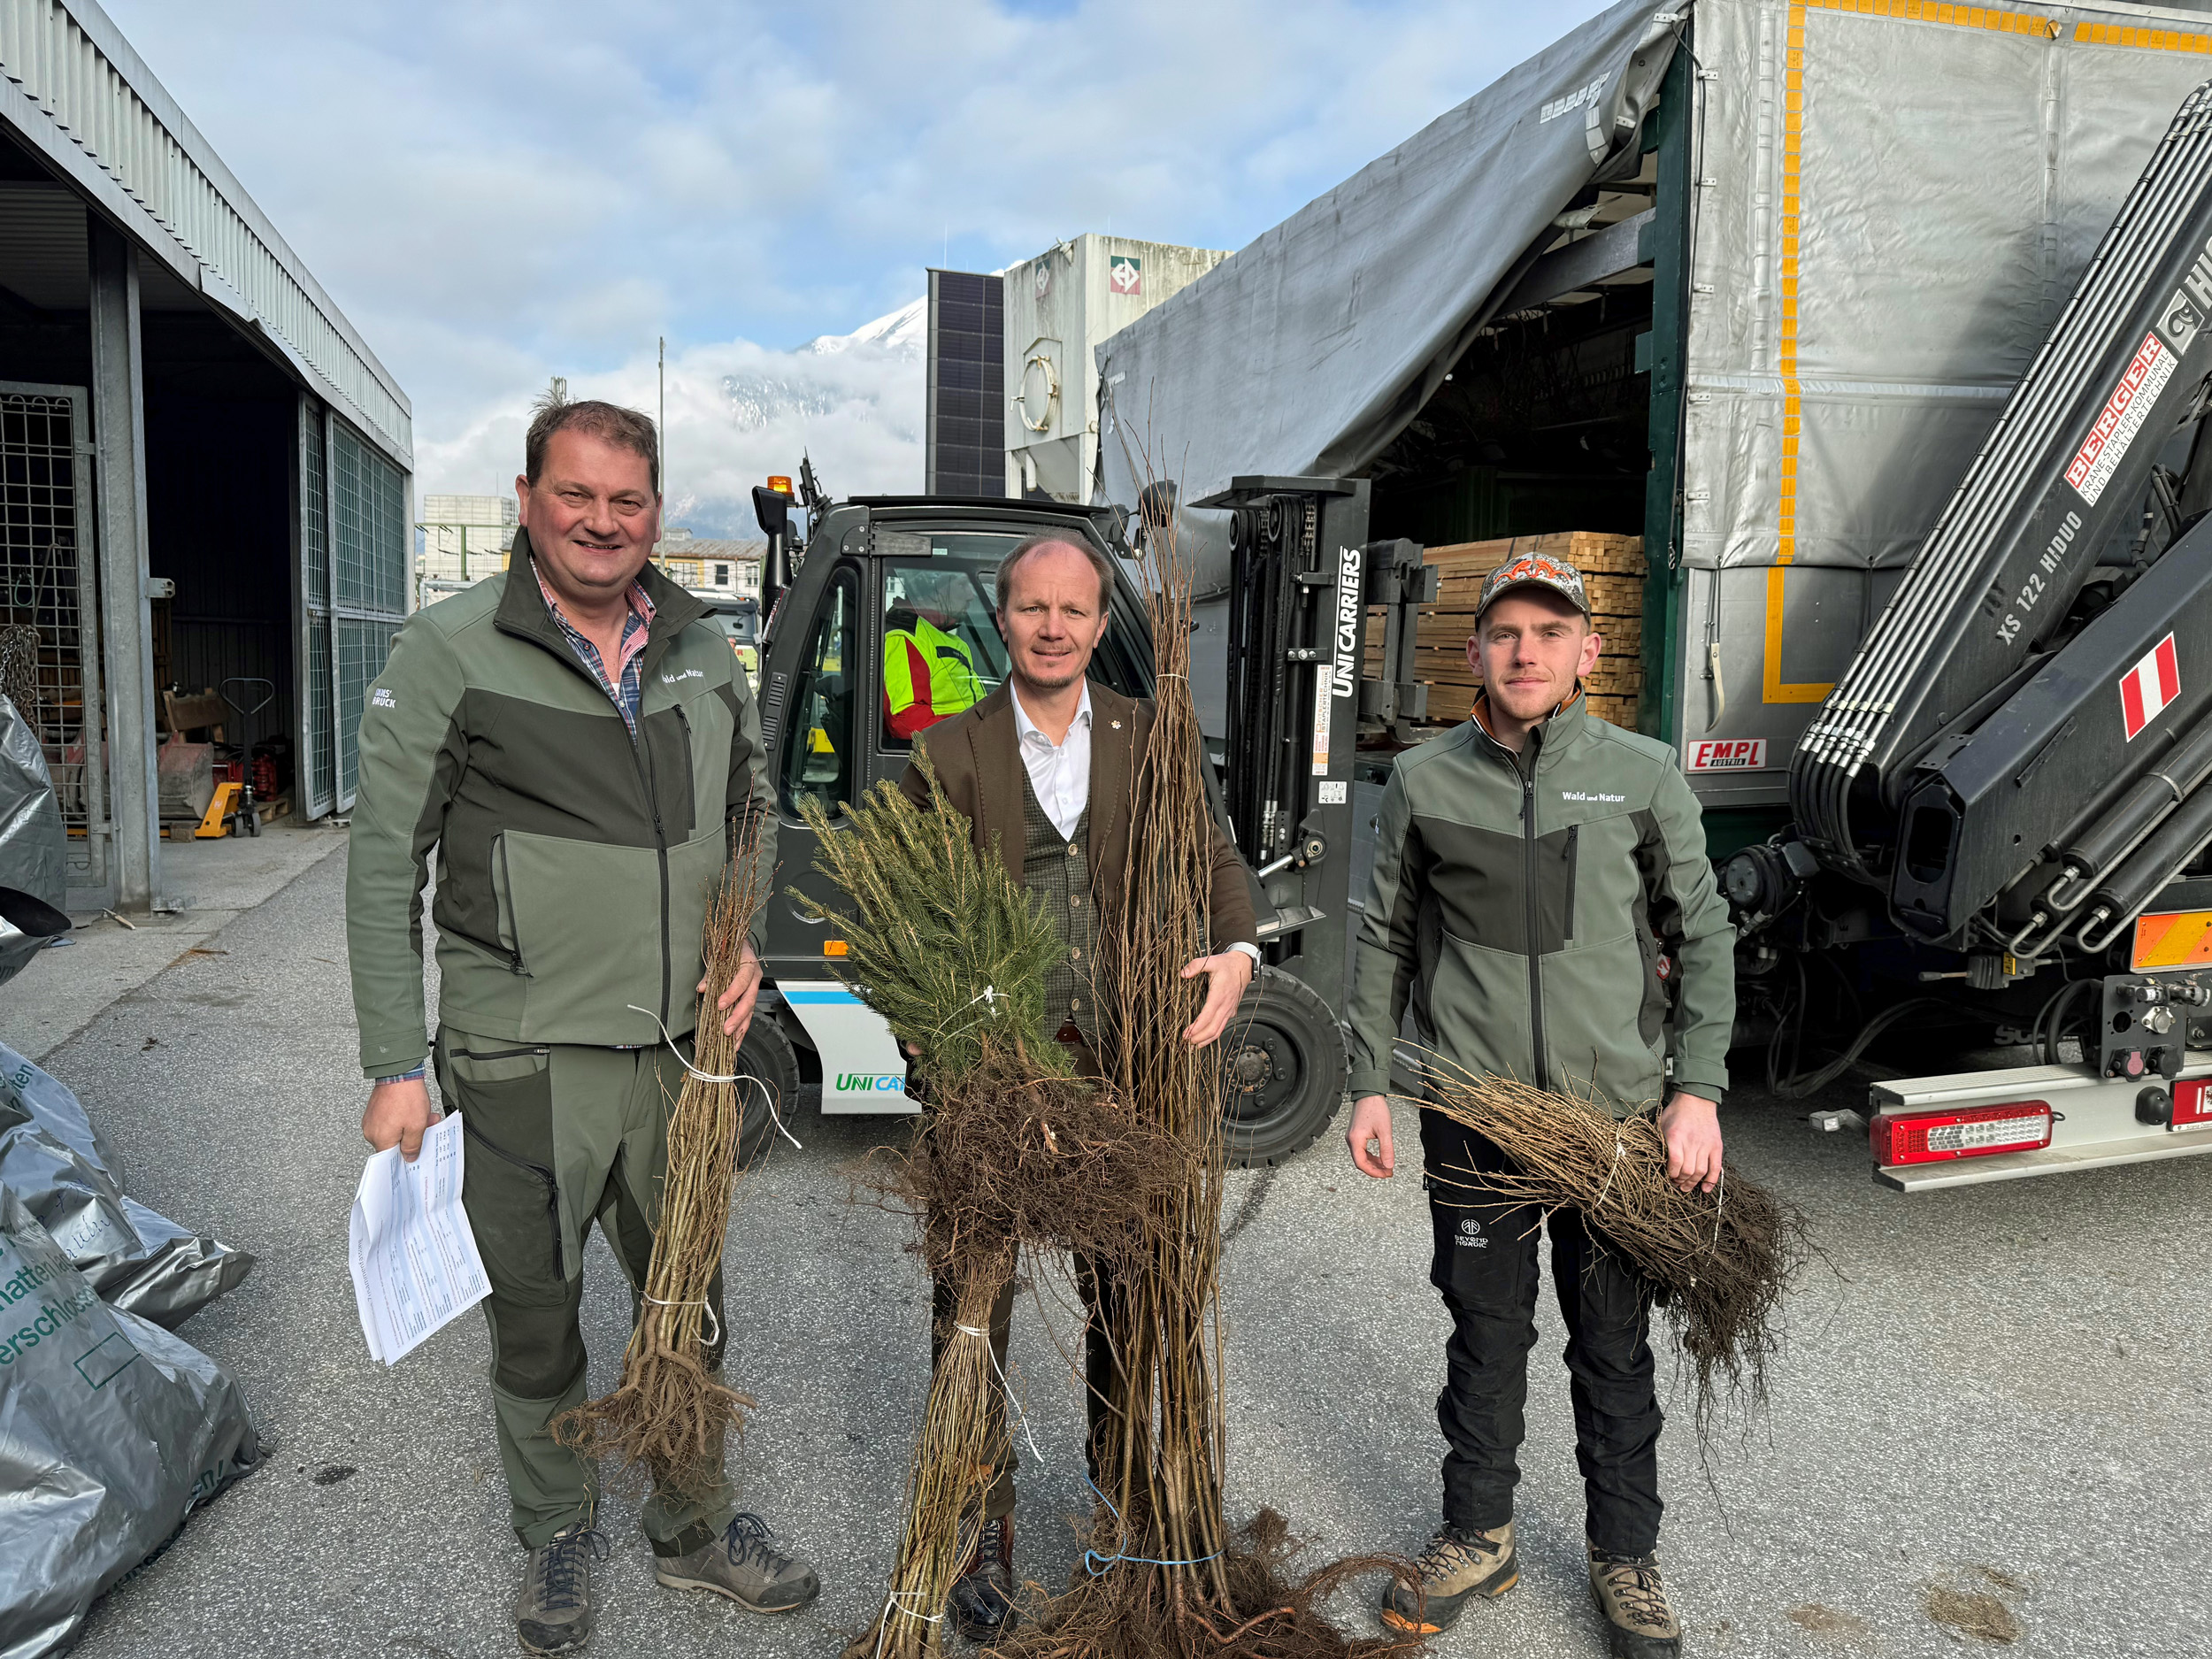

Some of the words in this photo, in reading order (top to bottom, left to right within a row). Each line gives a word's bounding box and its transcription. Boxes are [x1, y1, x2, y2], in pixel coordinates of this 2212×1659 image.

[2067, 336, 2161, 487] BERGER
[2081, 350, 2170, 497] KRÄNE-STAPLER-KOMMUNAL-
[2087, 477, 2107, 504] UND
[2105, 360, 2177, 474] BEHÄLTERTECHNIK
[1996, 613, 2022, 646] XS
[2016, 572, 2047, 612] 122
[372, 696, 396, 709] BRUCK
[1694, 741, 1760, 768] EMPL
[1712, 757, 1744, 767] AUSTRIA
[1562, 791, 1586, 801] Wald
[1599, 793, 1626, 803] Natur
